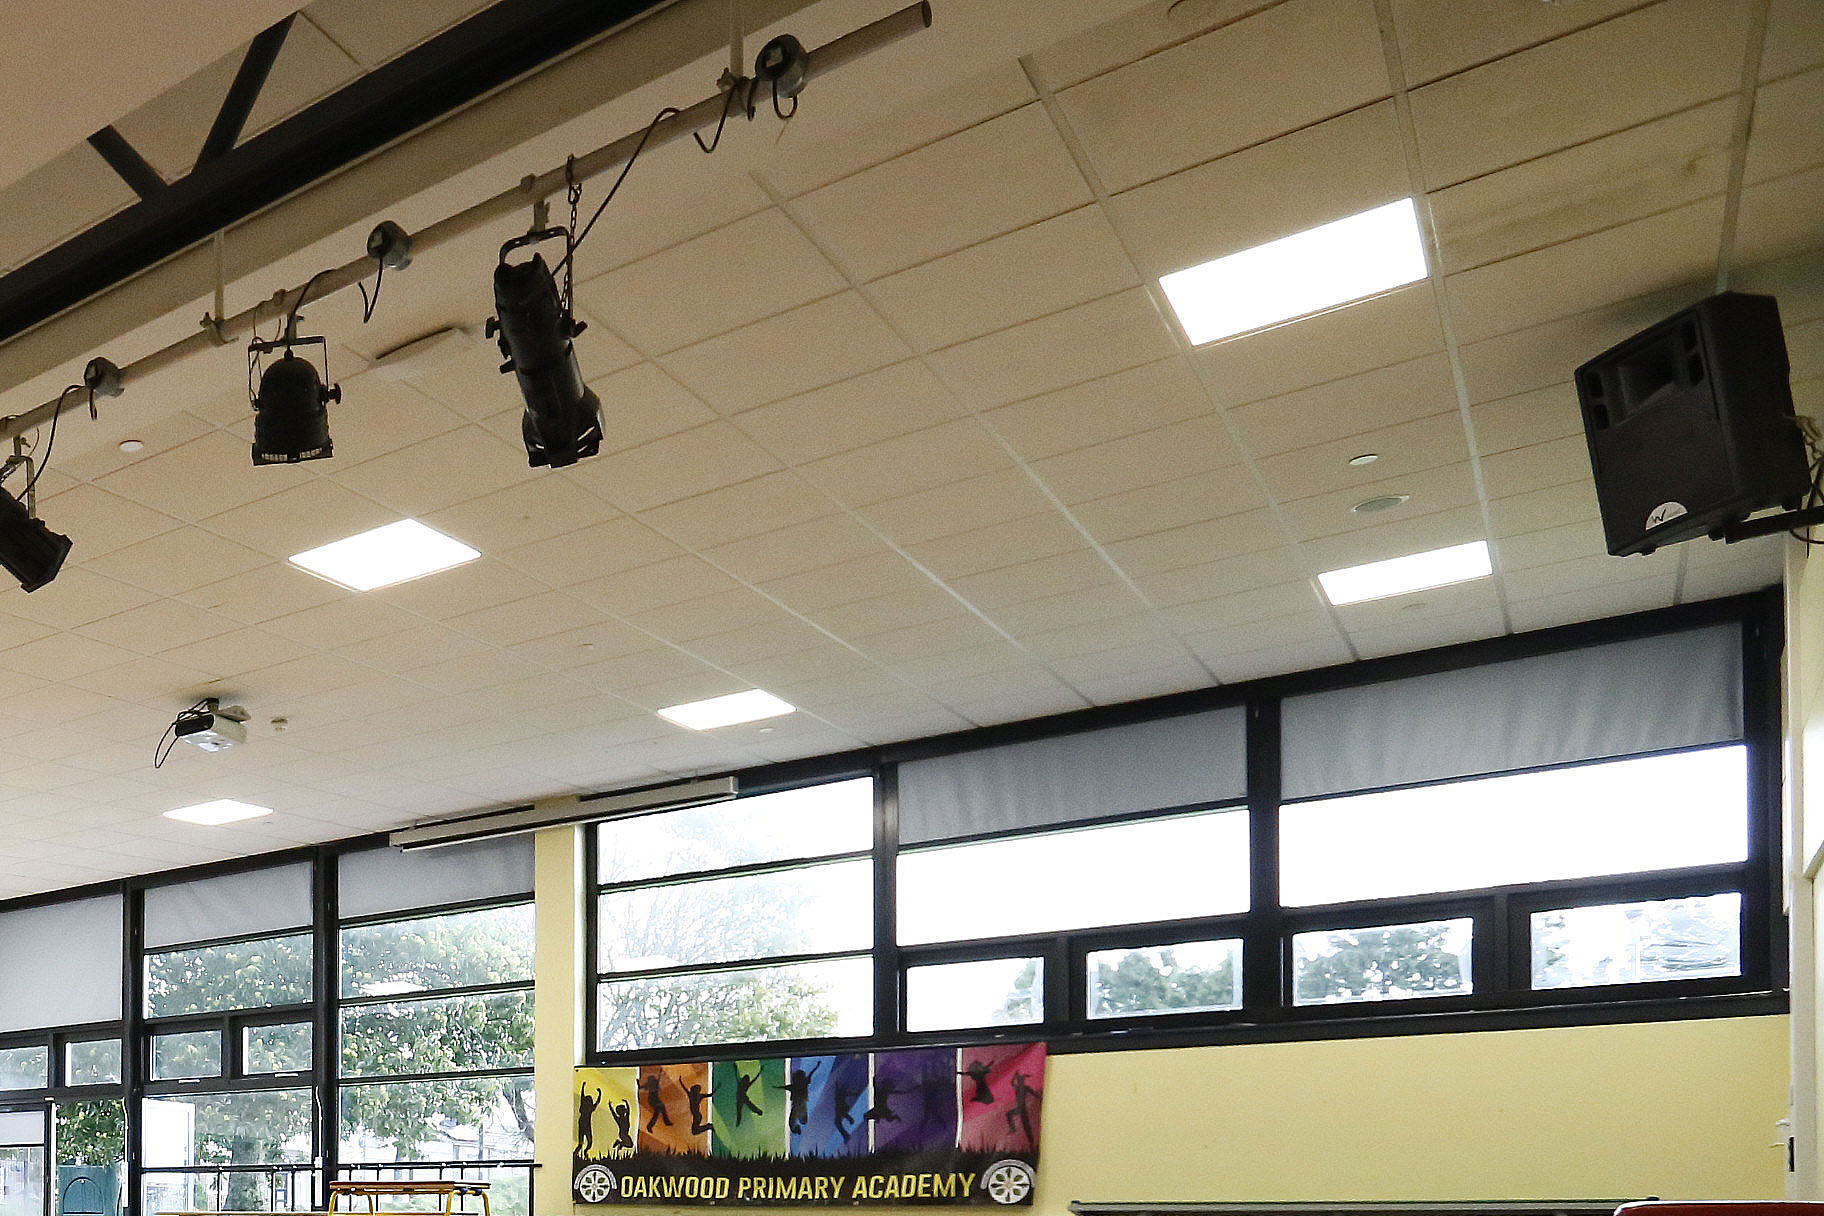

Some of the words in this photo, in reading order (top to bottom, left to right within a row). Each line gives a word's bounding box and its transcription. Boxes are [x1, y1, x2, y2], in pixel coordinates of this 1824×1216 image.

[620, 1175, 730, 1199] OAKWOOD
[737, 1175, 846, 1200] PRIMARY
[851, 1172, 976, 1199] ACADEMY
